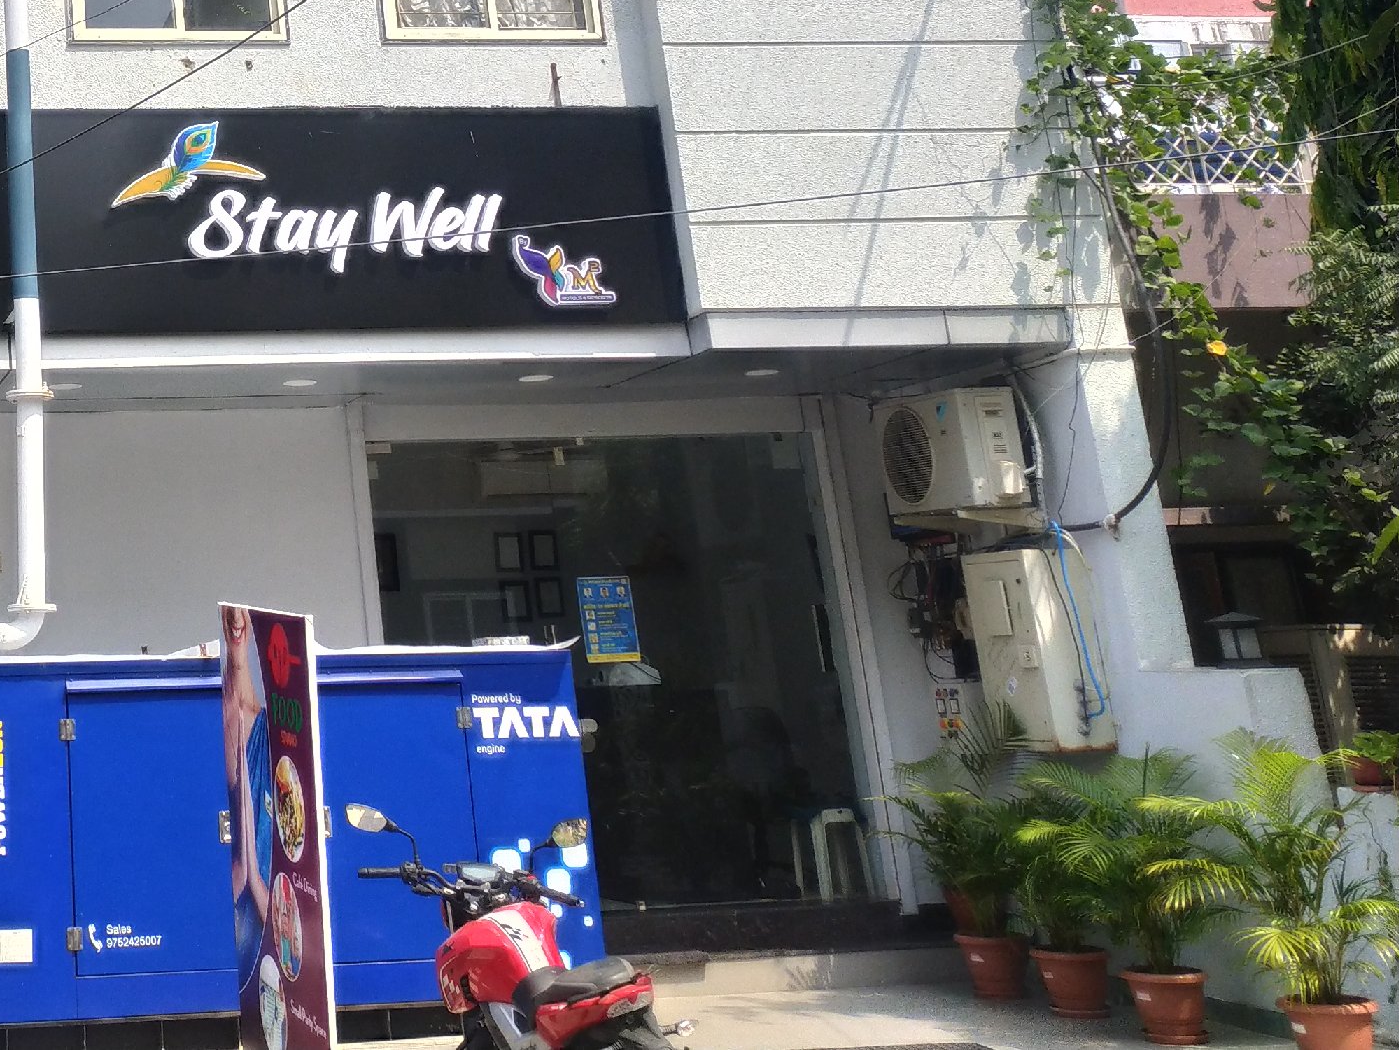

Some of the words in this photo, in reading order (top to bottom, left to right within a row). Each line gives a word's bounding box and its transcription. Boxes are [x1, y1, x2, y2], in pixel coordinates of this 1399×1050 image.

[187, 188, 360, 273] Stay
[370, 186, 502, 258] Well
[471, 693, 508, 704] Powered
[509, 692, 521, 704] by
[472, 706, 580, 738] TATA
[476, 743, 506, 754] engine
[106, 924, 132, 935] Sales
